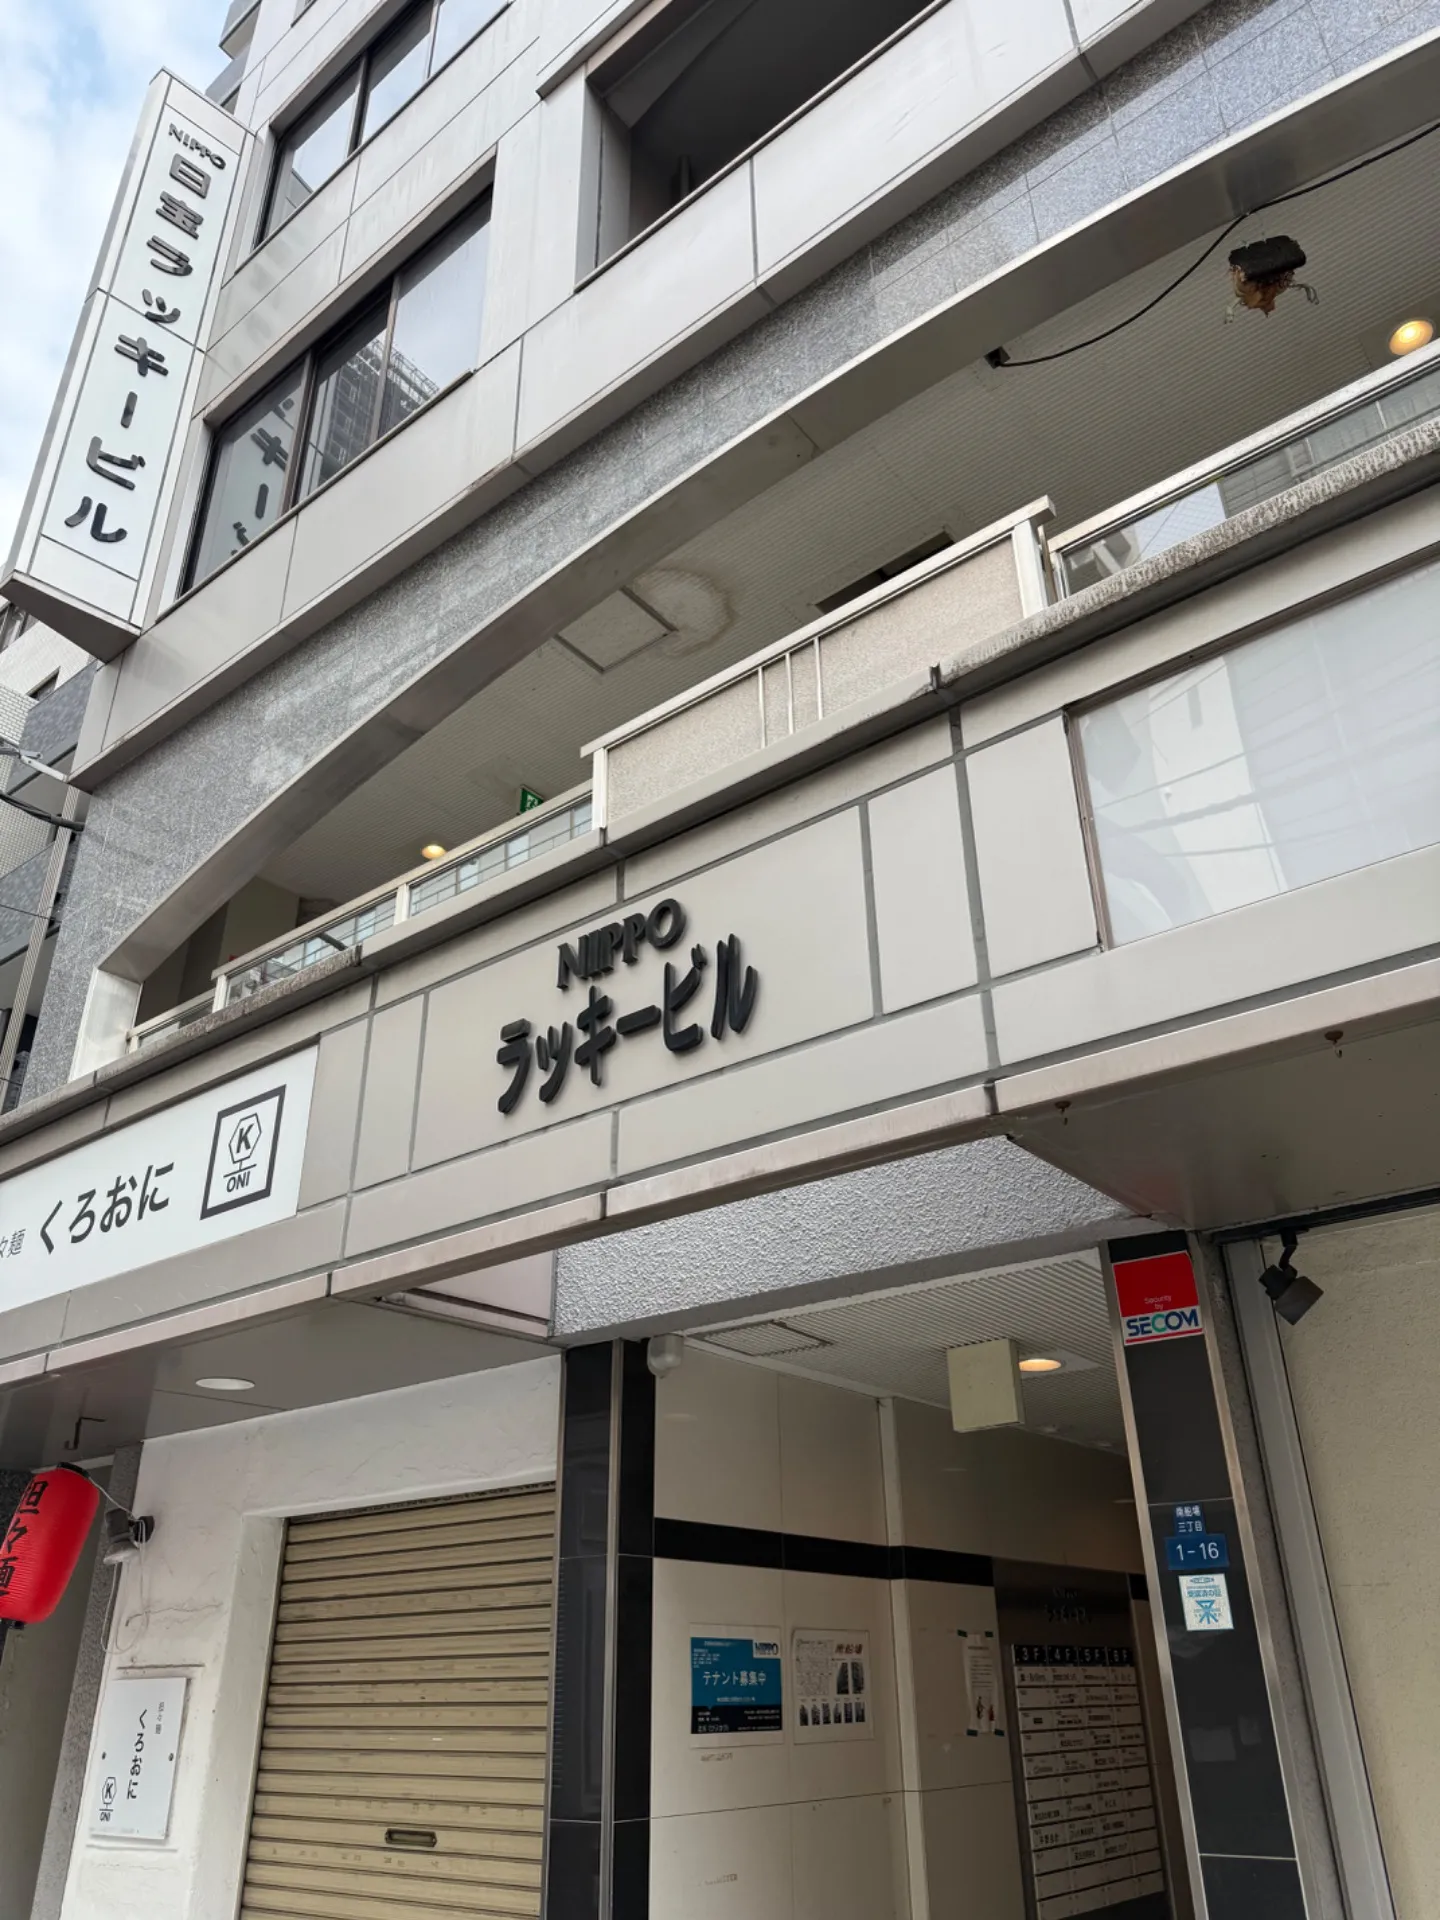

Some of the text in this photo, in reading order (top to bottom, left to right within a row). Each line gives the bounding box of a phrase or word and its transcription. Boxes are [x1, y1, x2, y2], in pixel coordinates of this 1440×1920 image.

[168, 122, 227, 170] NIPPO
[64, 153, 209, 544] 日宝ラッキービル
[556, 898, 687, 990] NIPPO
[496, 933, 759, 1115] ラッキービル
[236, 1124, 254, 1154] K
[226, 1171, 251, 1193] ONI
[40, 1162, 175, 1255] くろおに
[1144, 1294, 1172, 1305] Security
[1126, 1308, 1199, 1337] SECOM
[1177, 1519, 1203, 1533] 三丁目
[1176, 1542, 1219, 1561] 1-16
[702, 1670, 767, 1687] テナント募集中
[127, 1709, 148, 1800] くろおに
[104, 1782, 114, 1799] K
